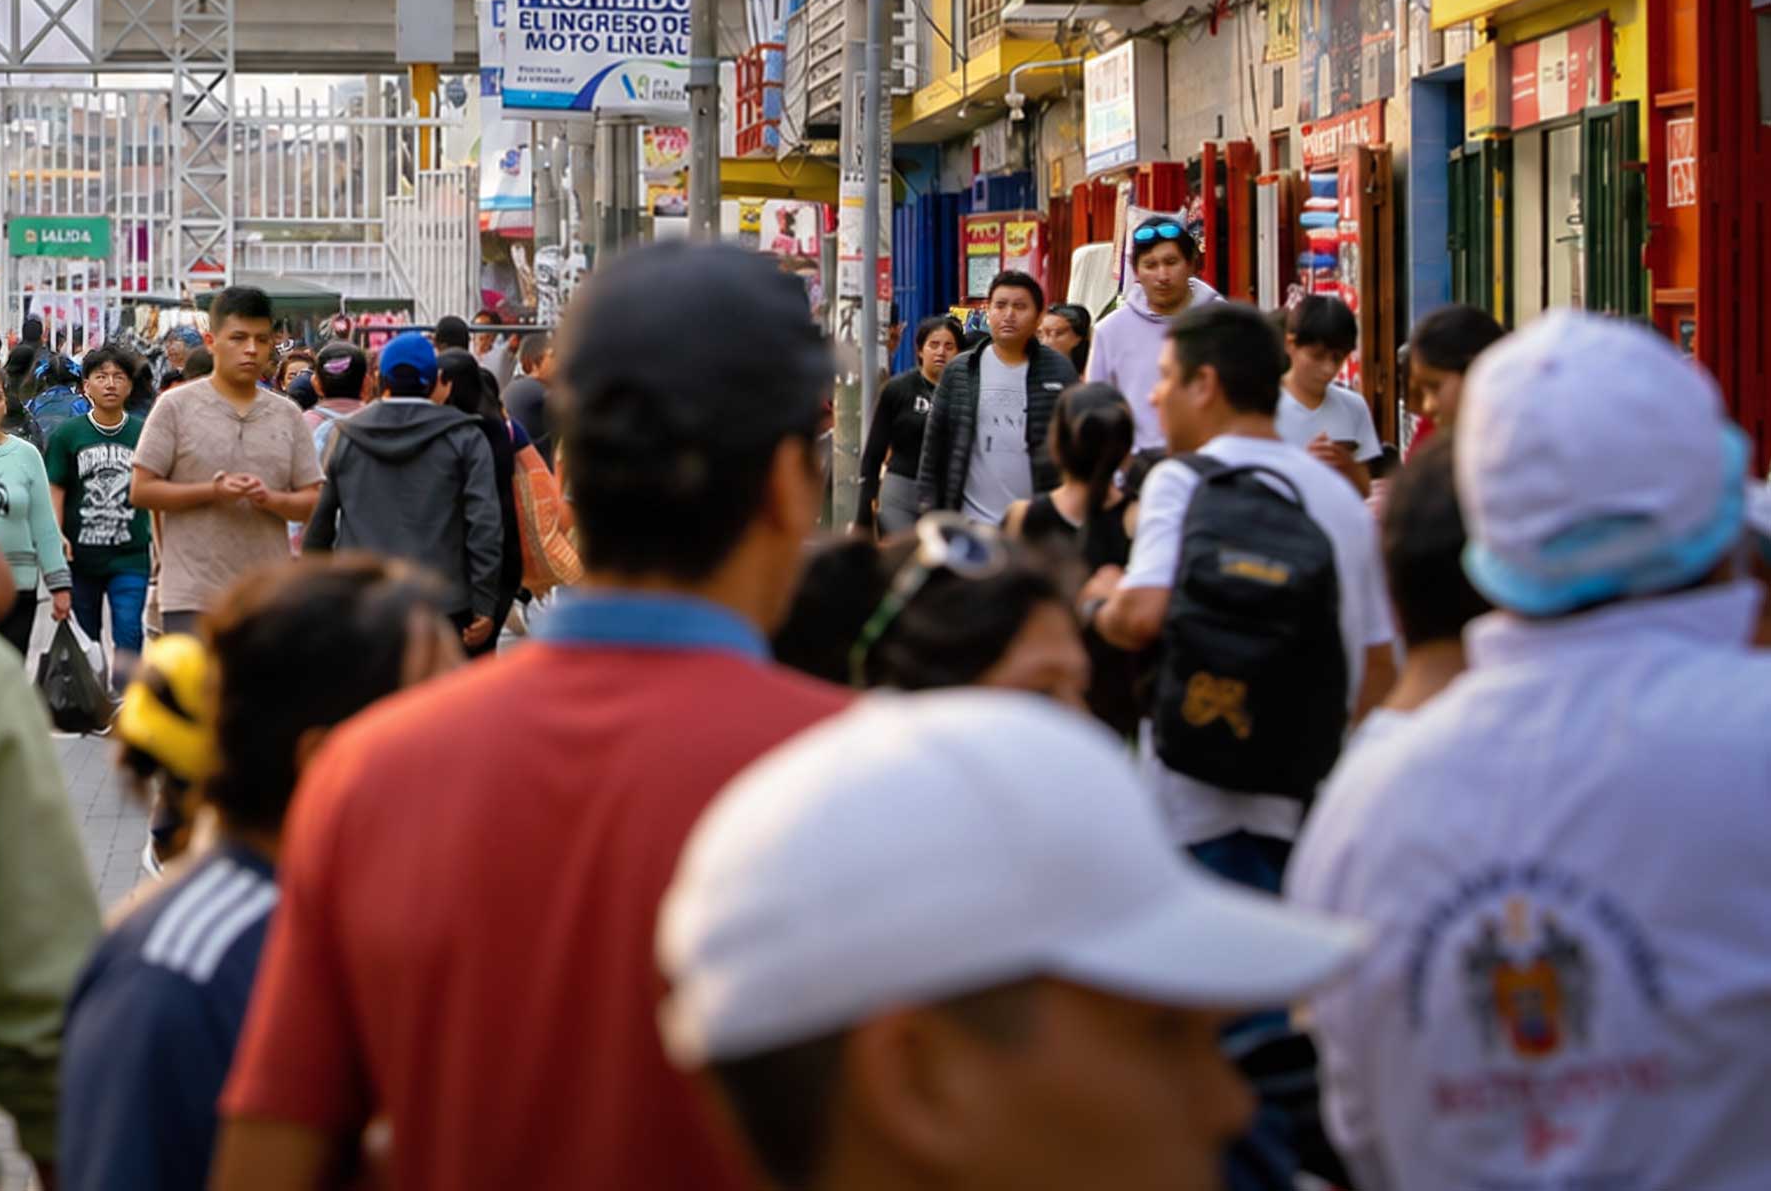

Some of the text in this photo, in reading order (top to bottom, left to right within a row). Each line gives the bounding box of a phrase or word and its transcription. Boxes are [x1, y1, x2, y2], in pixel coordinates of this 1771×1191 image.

[519, 11, 545, 30] EL
[551, 12, 657, 35] INGRESO
[662, 16, 691, 36] DE
[525, 33, 688, 55] MOTO LINEAL
